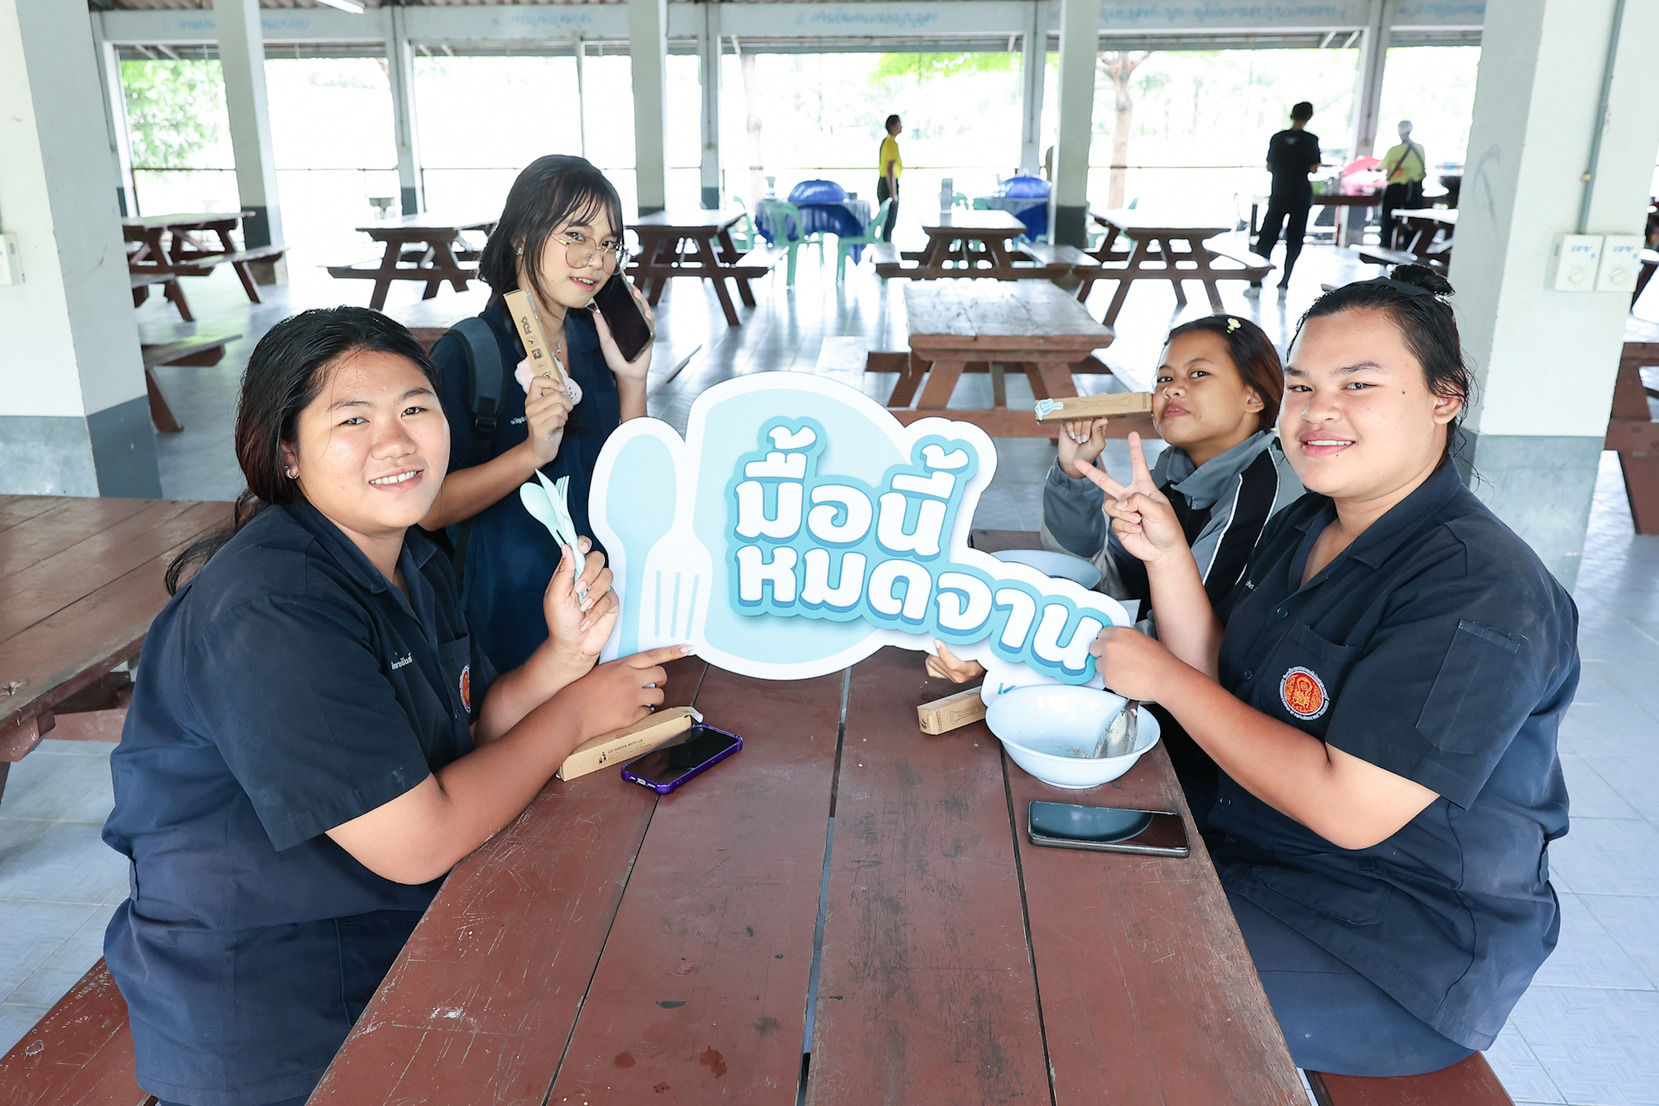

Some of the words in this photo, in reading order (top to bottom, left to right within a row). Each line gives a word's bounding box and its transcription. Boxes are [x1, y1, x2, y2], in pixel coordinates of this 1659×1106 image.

[735, 424, 970, 559] มื้อนี้
[735, 544, 1103, 674] หมดจาน
